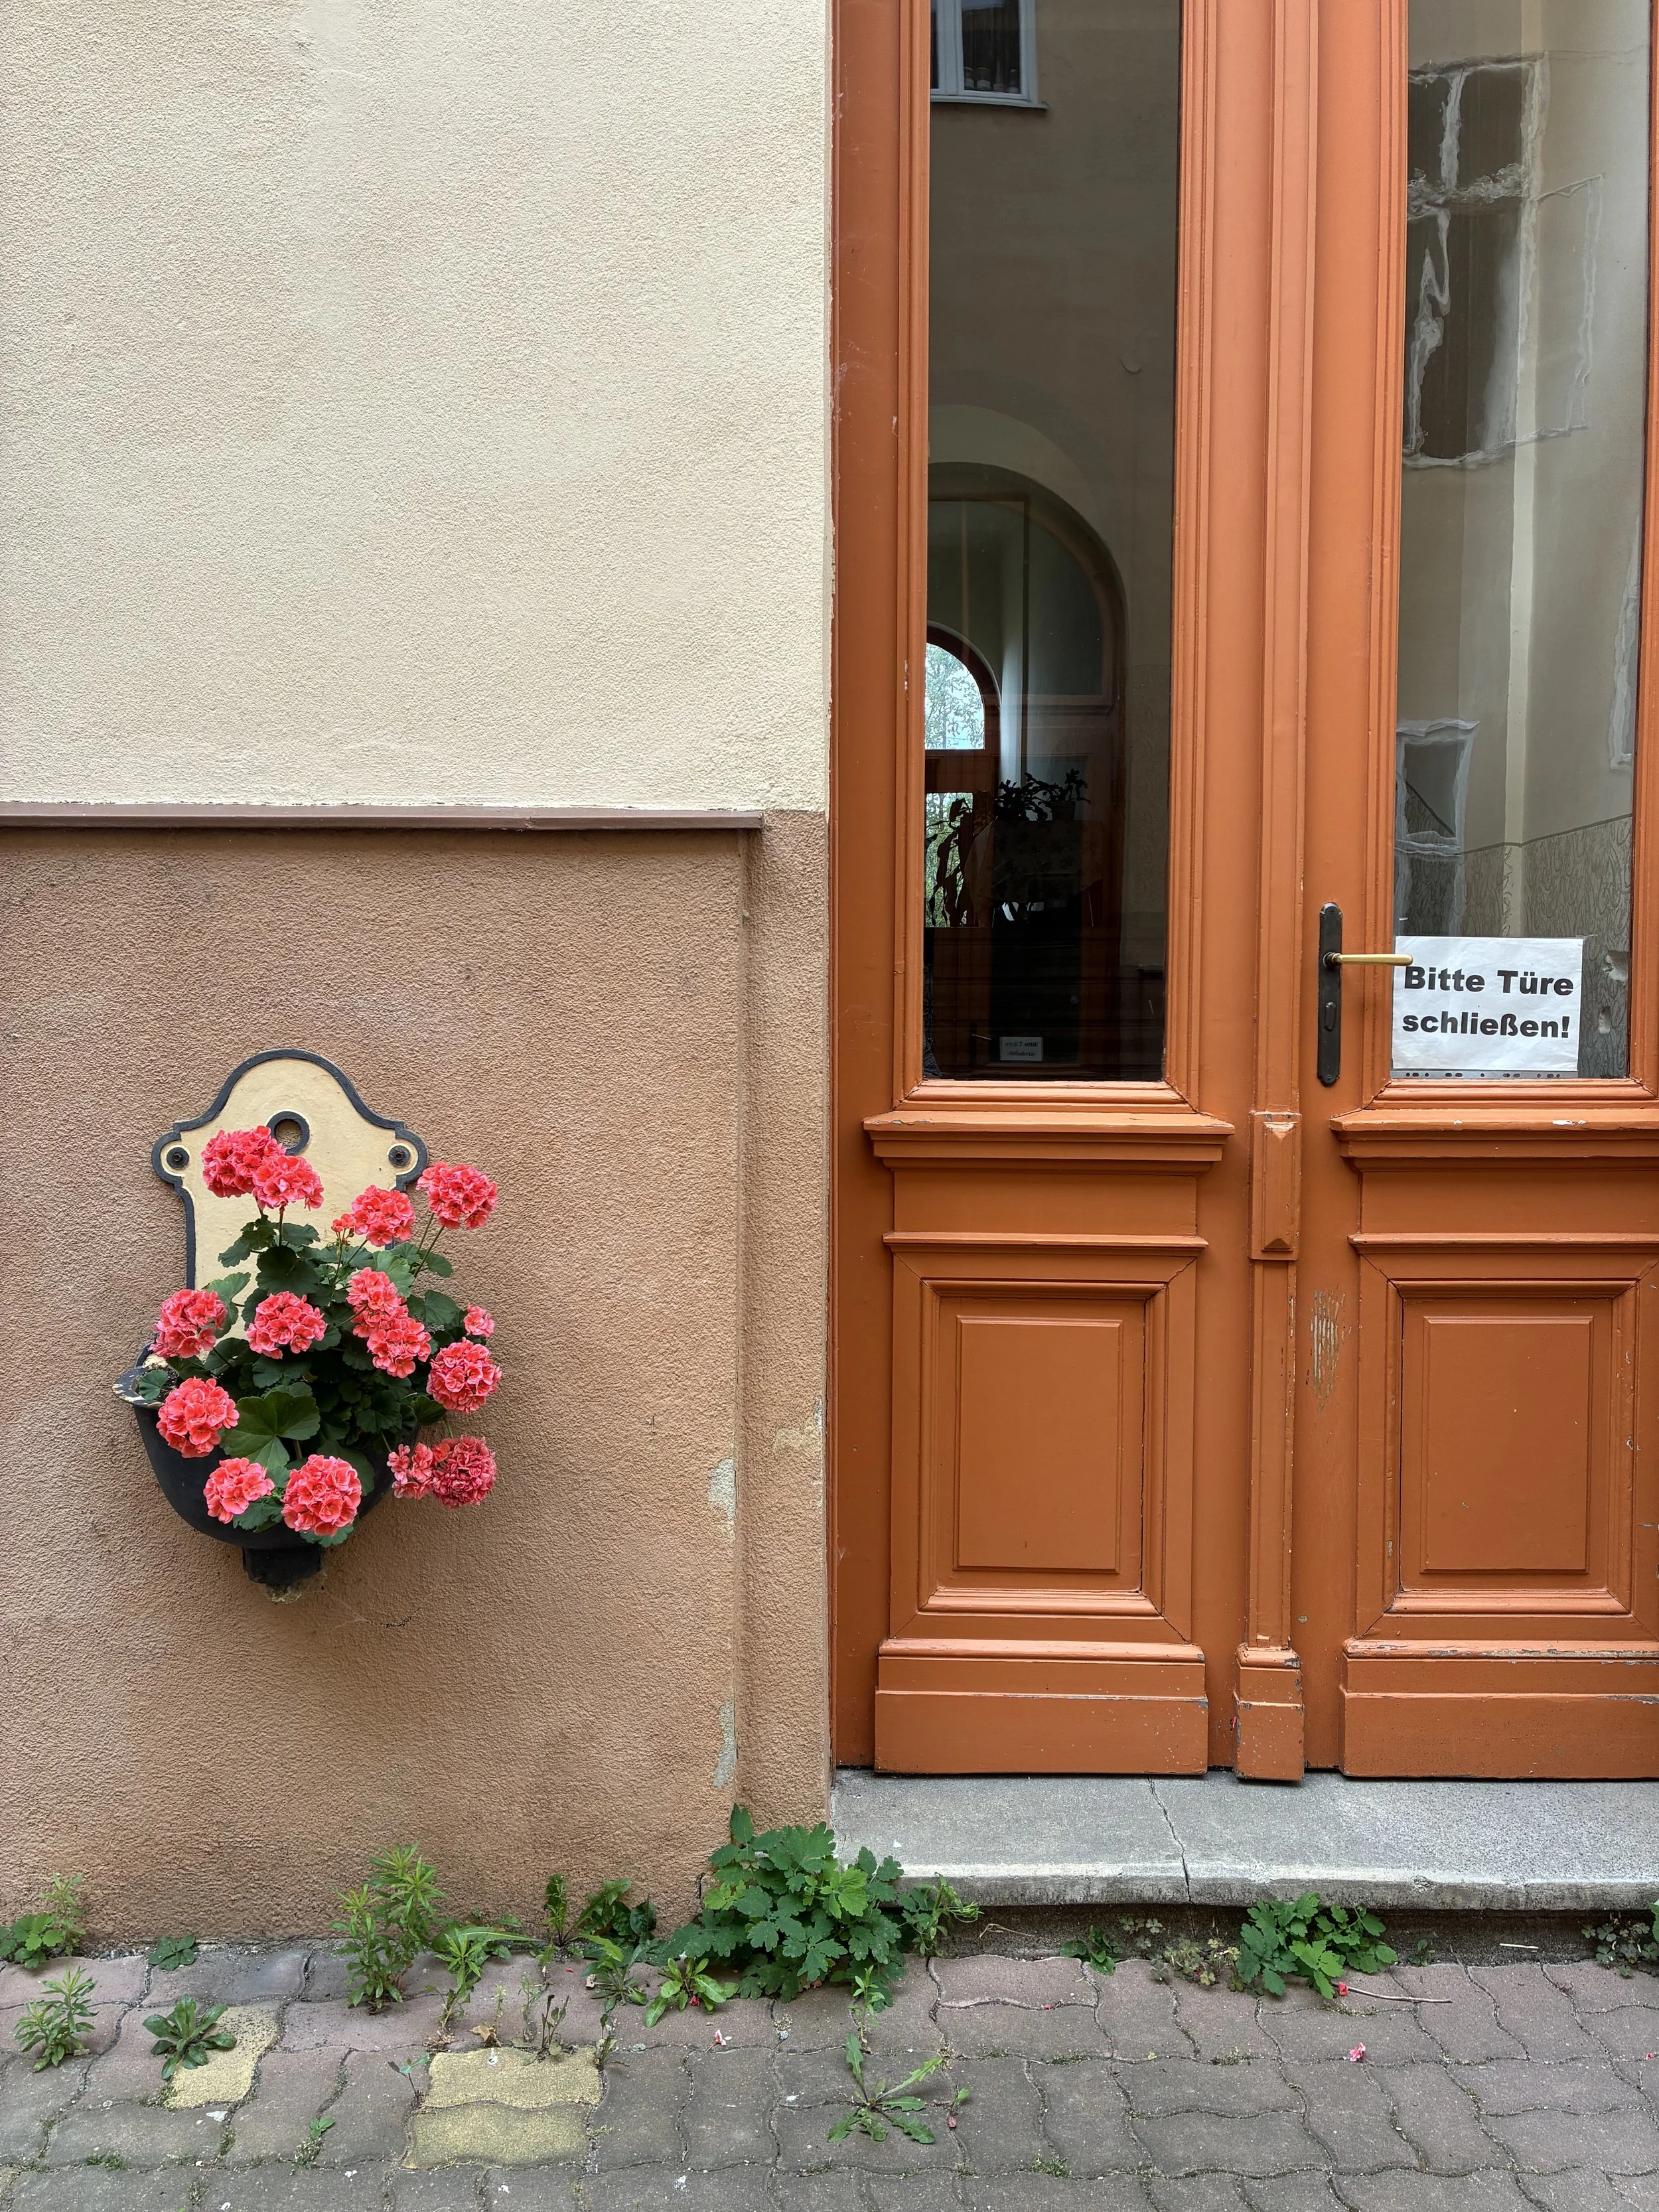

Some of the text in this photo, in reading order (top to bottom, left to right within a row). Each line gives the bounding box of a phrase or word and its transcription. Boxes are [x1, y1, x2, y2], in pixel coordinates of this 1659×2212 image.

[1404, 966, 1574, 996] Bitte Türe
[1402, 1011, 1570, 1039] schließen!
